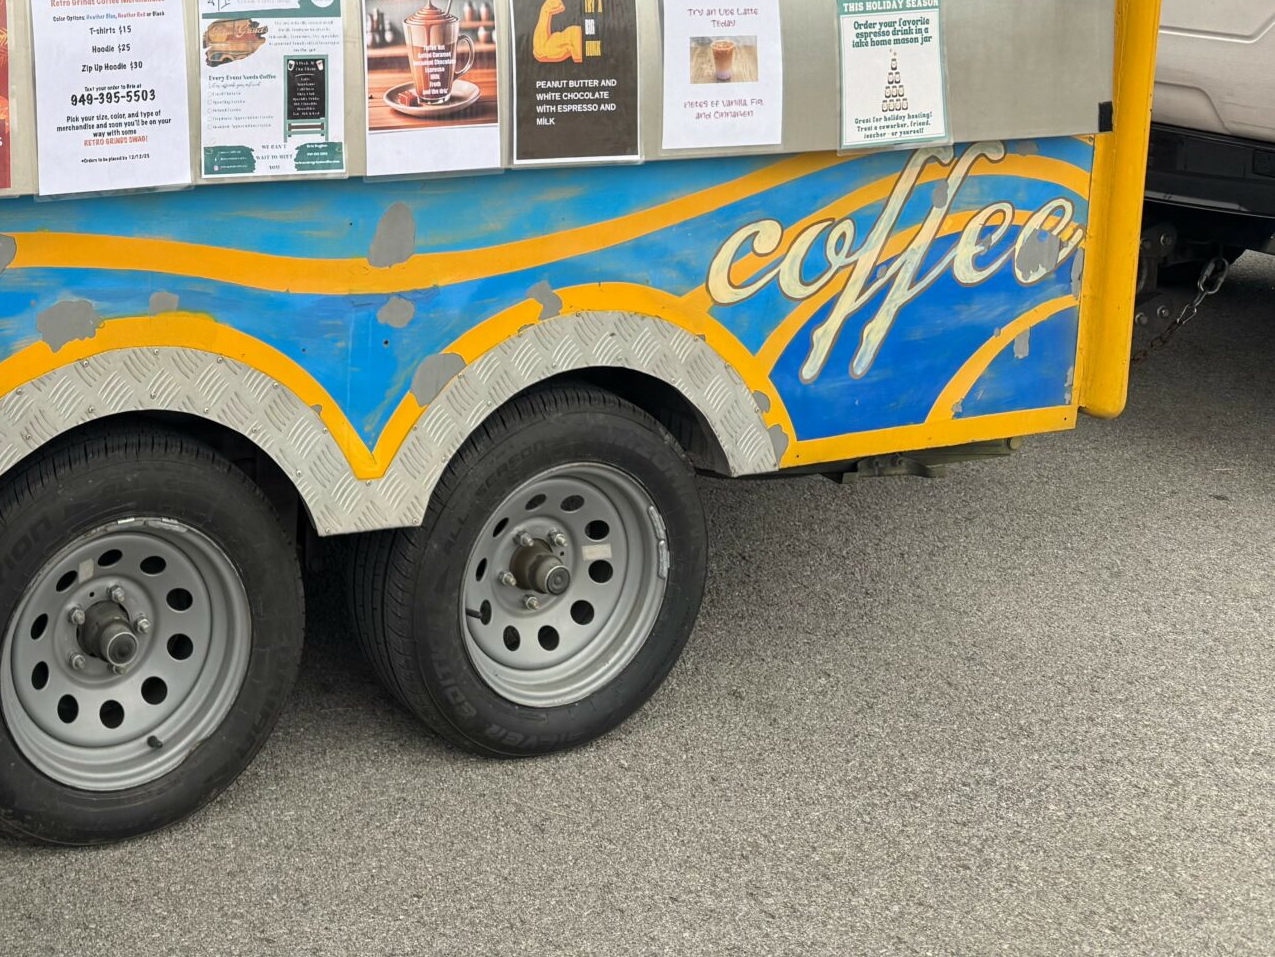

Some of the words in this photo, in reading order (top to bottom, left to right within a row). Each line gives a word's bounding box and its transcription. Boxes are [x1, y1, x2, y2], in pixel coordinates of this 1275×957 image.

[843, 2, 865, 12] THIS
[865, 0, 904, 10] HOLIDAY
[853, 20, 877, 30] Order
[878, 20, 897, 30] your
[898, 17, 930, 28] favorite
[89, 27, 116, 35] T-shirts
[119, 25, 132, 34] $15
[855, 28, 890, 39] espresso
[891, 26, 913, 36] drink
[914, 26, 923, 36] in
[852, 38, 869, 48] take
[870, 37, 893, 46] home
[893, 36, 919, 44] mason
[921, 34, 933, 46] jar
[92, 45, 114, 53] Hoodie
[118, 44, 131, 53] $25
[81, 65, 92, 73] Zip
[94, 64, 103, 73] Up
[130, 61, 143, 71] $30
[536, 80, 567, 88] PEANUT
[70, 89, 156, 106] 949-395-5503
[562, 91, 609, 99] CHOCOLATE
[557, 104, 598, 112] ESPRESSO
[600, 103, 616, 111] AND
[706, 136, 1086, 384] coffee
